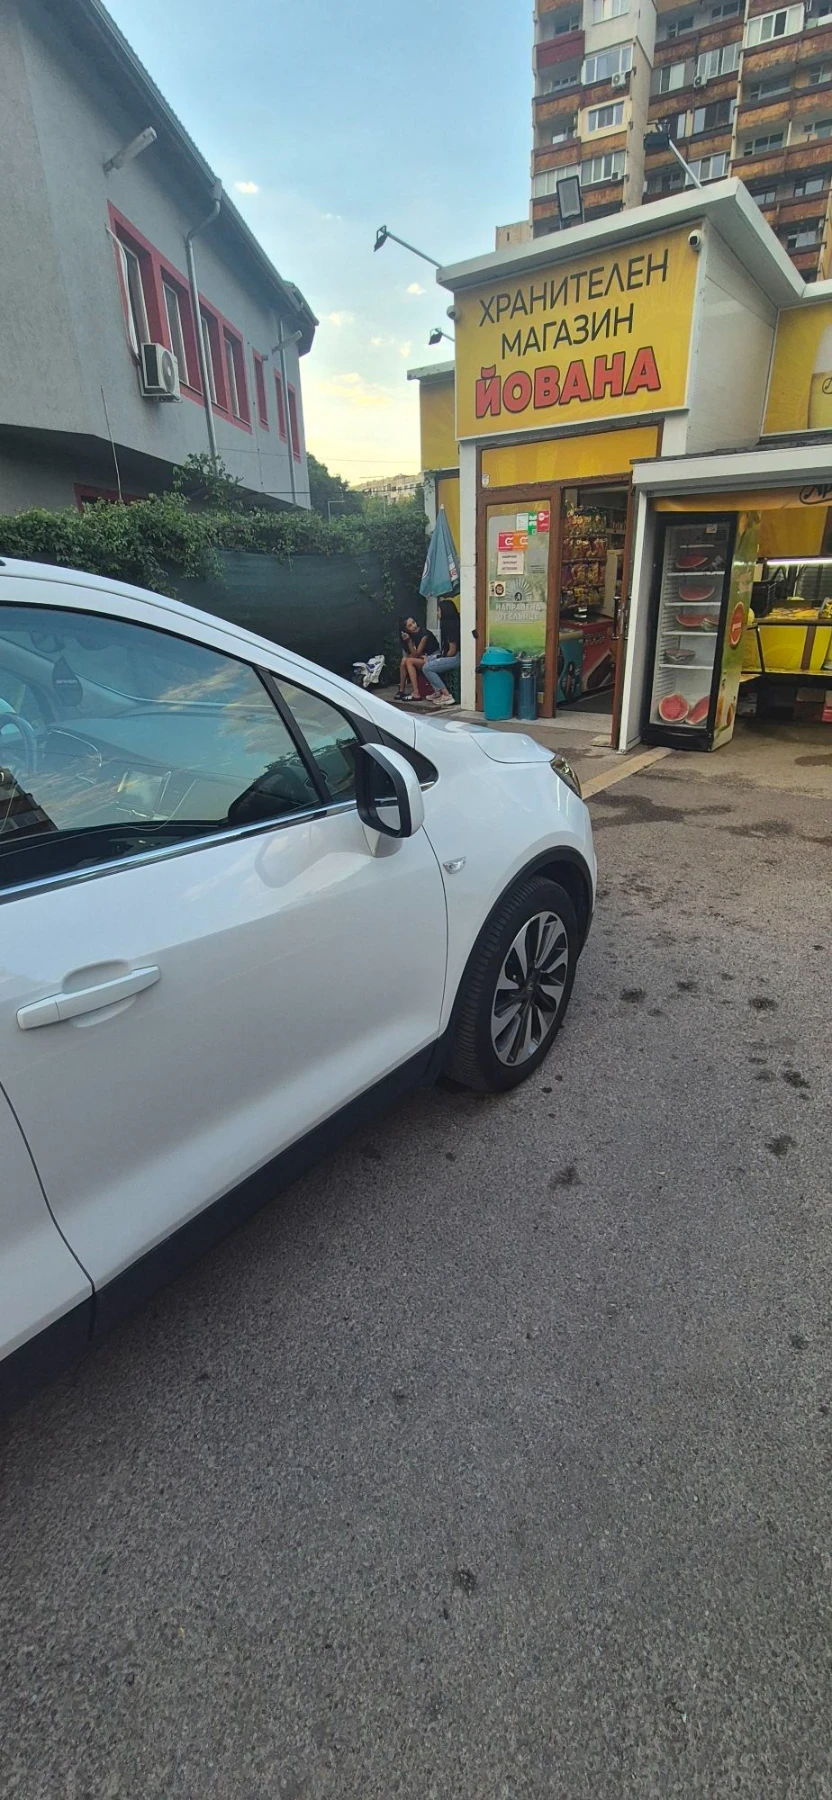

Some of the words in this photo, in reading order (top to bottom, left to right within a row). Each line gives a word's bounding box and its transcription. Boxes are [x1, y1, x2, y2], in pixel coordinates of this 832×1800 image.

[479, 248, 669, 327] ХРАНИТЕЛЕН
[501, 303, 635, 360] МАГАЗИН
[475, 346, 662, 419] ЙОВАНА
